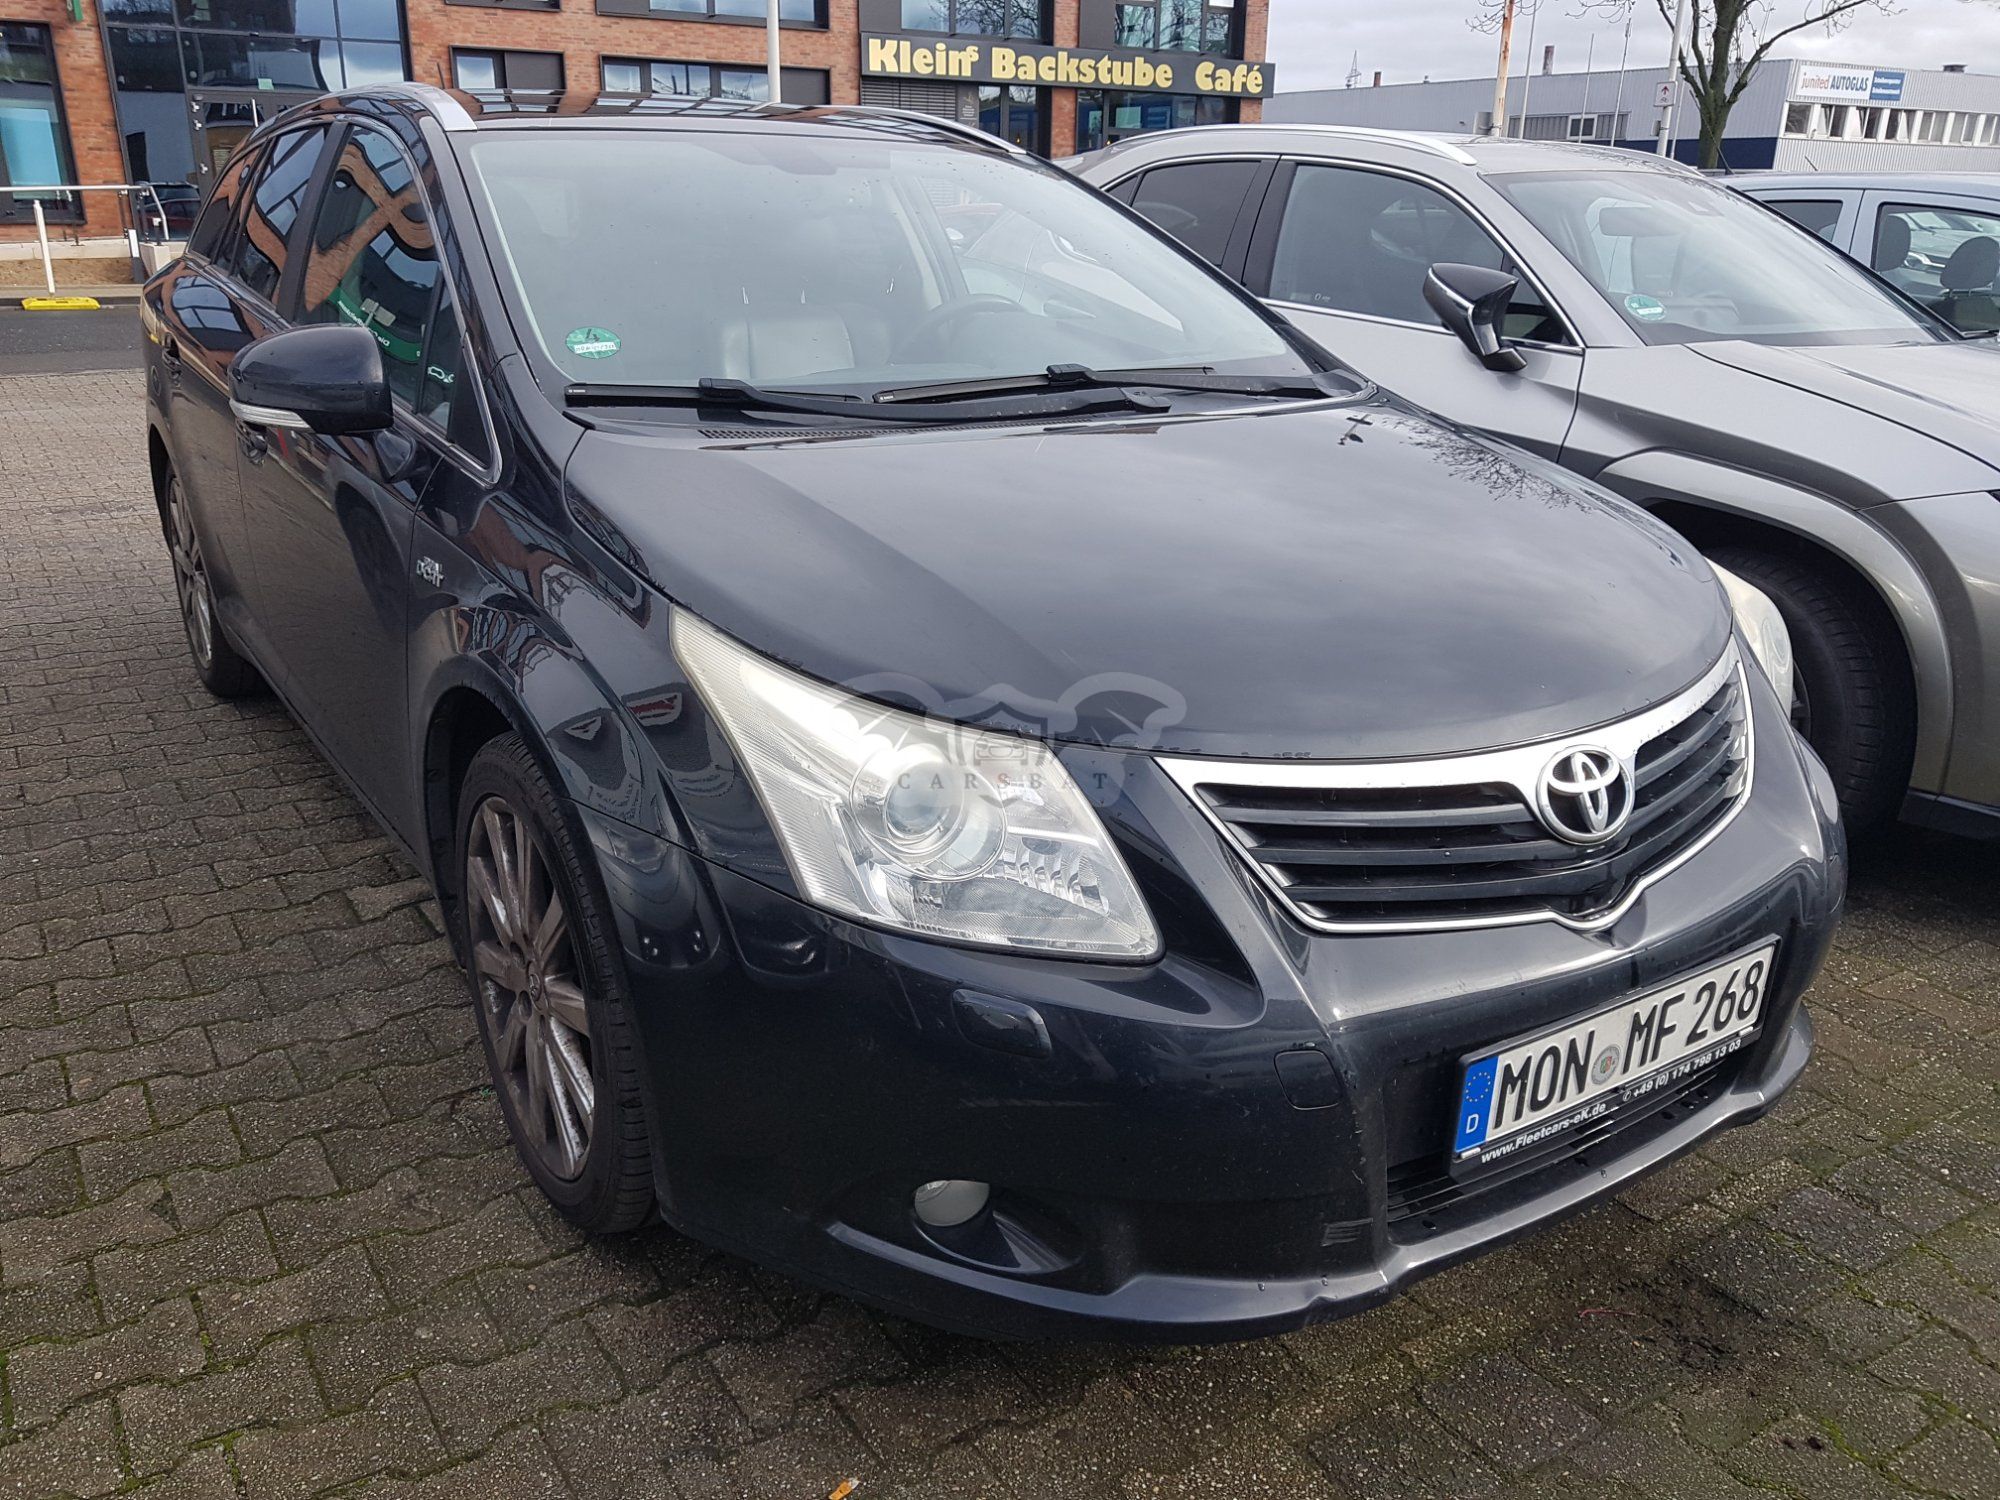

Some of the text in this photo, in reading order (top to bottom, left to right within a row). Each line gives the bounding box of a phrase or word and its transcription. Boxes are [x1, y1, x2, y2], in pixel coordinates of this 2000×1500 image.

[991, 47, 1173, 88] Backstube
[1194, 62, 1263, 94] Café
[1801, 72, 1829, 89] junited
[1829, 75, 1869, 92] AUTOGLAS
[1492, 960, 1765, 1130] MON MF 268
[1465, 1113, 1479, 1134] D
[1481, 1039, 1742, 1163] www.Fleetcars-eK.de +49 (0) 174 798 13 03
